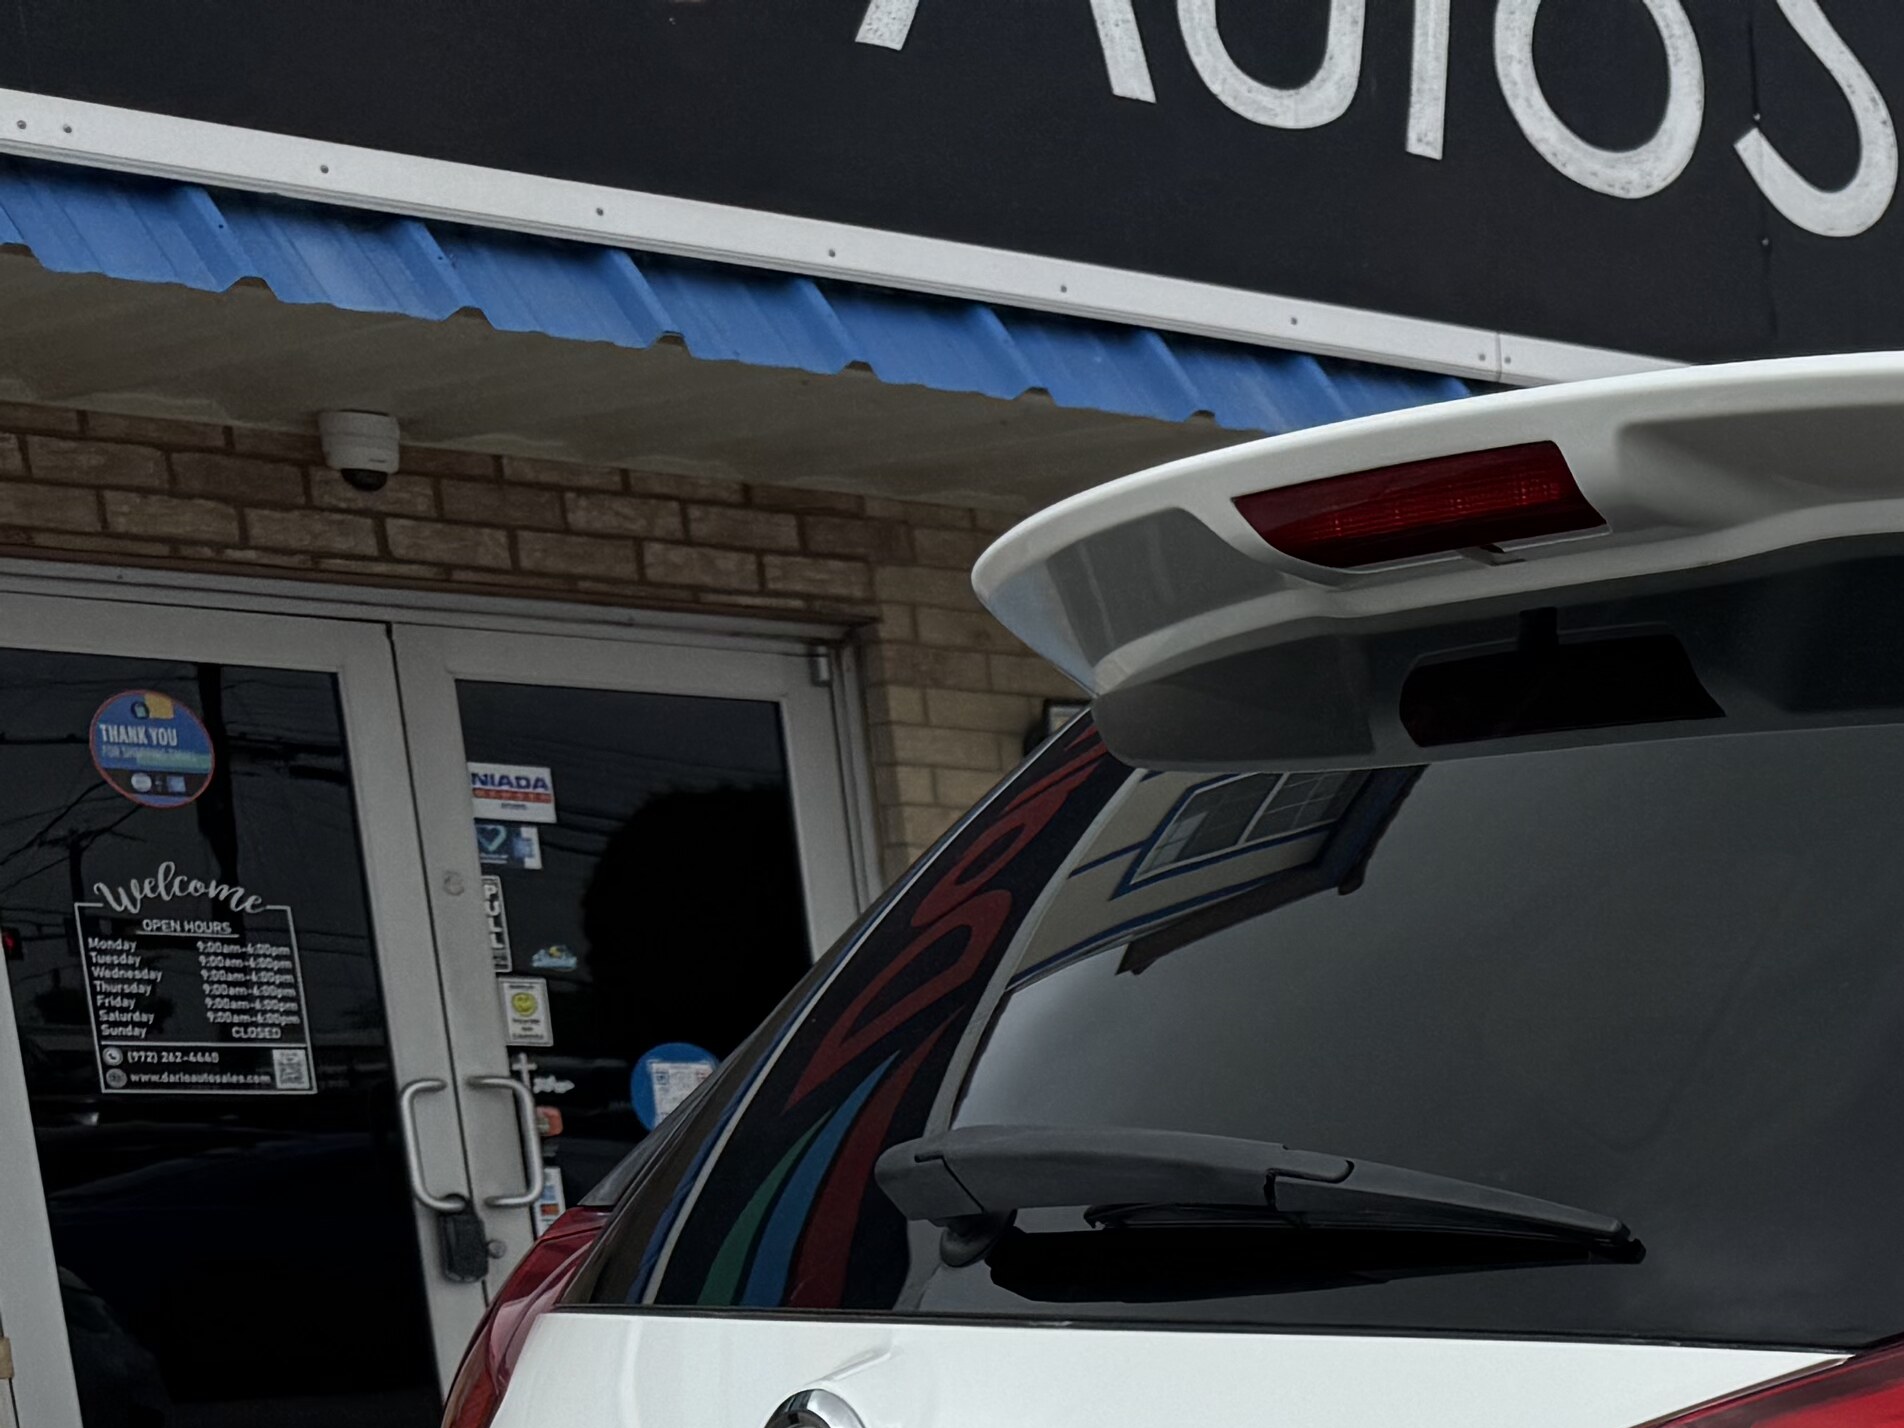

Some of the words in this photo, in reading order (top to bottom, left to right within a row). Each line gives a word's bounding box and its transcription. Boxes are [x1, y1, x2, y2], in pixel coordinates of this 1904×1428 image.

[855, 0, 1706, 199] uo
[99, 724, 148, 745] THANK
[150, 727, 178, 746] YOU
[471, 773, 549, 791] NIADA
[94, 861, 265, 914] Welcome
[484, 883, 504, 949] PULL
[142, 919, 181, 933] OPEN
[184, 921, 232, 935] HOURS
[88, 938, 137, 952] Monday
[90, 952, 141, 966] Tuesday
[91, 966, 163, 982] Wednesday
[93, 981, 152, 996] Thursday
[96, 995, 136, 1009] Friday
[99, 1010, 154, 1024] Saturday
[101, 1024, 147, 1038] Sunday
[232, 1027, 281, 1039] CLOSED
